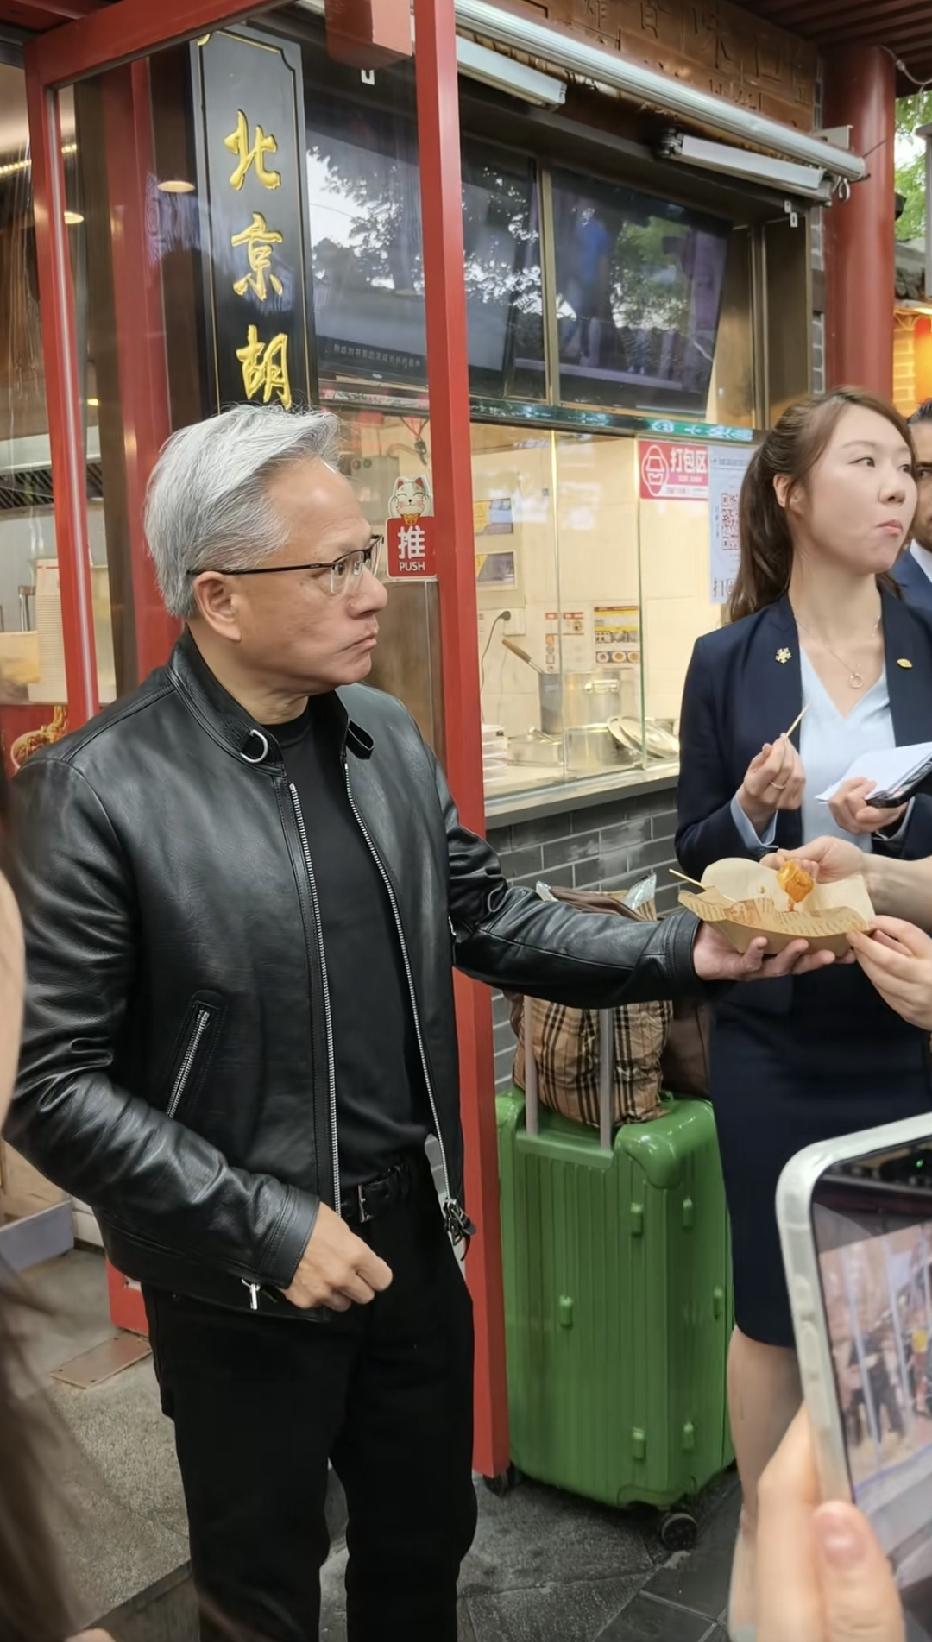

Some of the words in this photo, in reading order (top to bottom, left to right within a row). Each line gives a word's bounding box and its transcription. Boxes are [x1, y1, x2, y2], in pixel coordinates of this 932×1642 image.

[223, 108, 293, 411] 北京胡
[670, 447, 708, 474] 打包区
[397, 525, 426, 560] 推
[399, 562, 426, 571] PUSH
